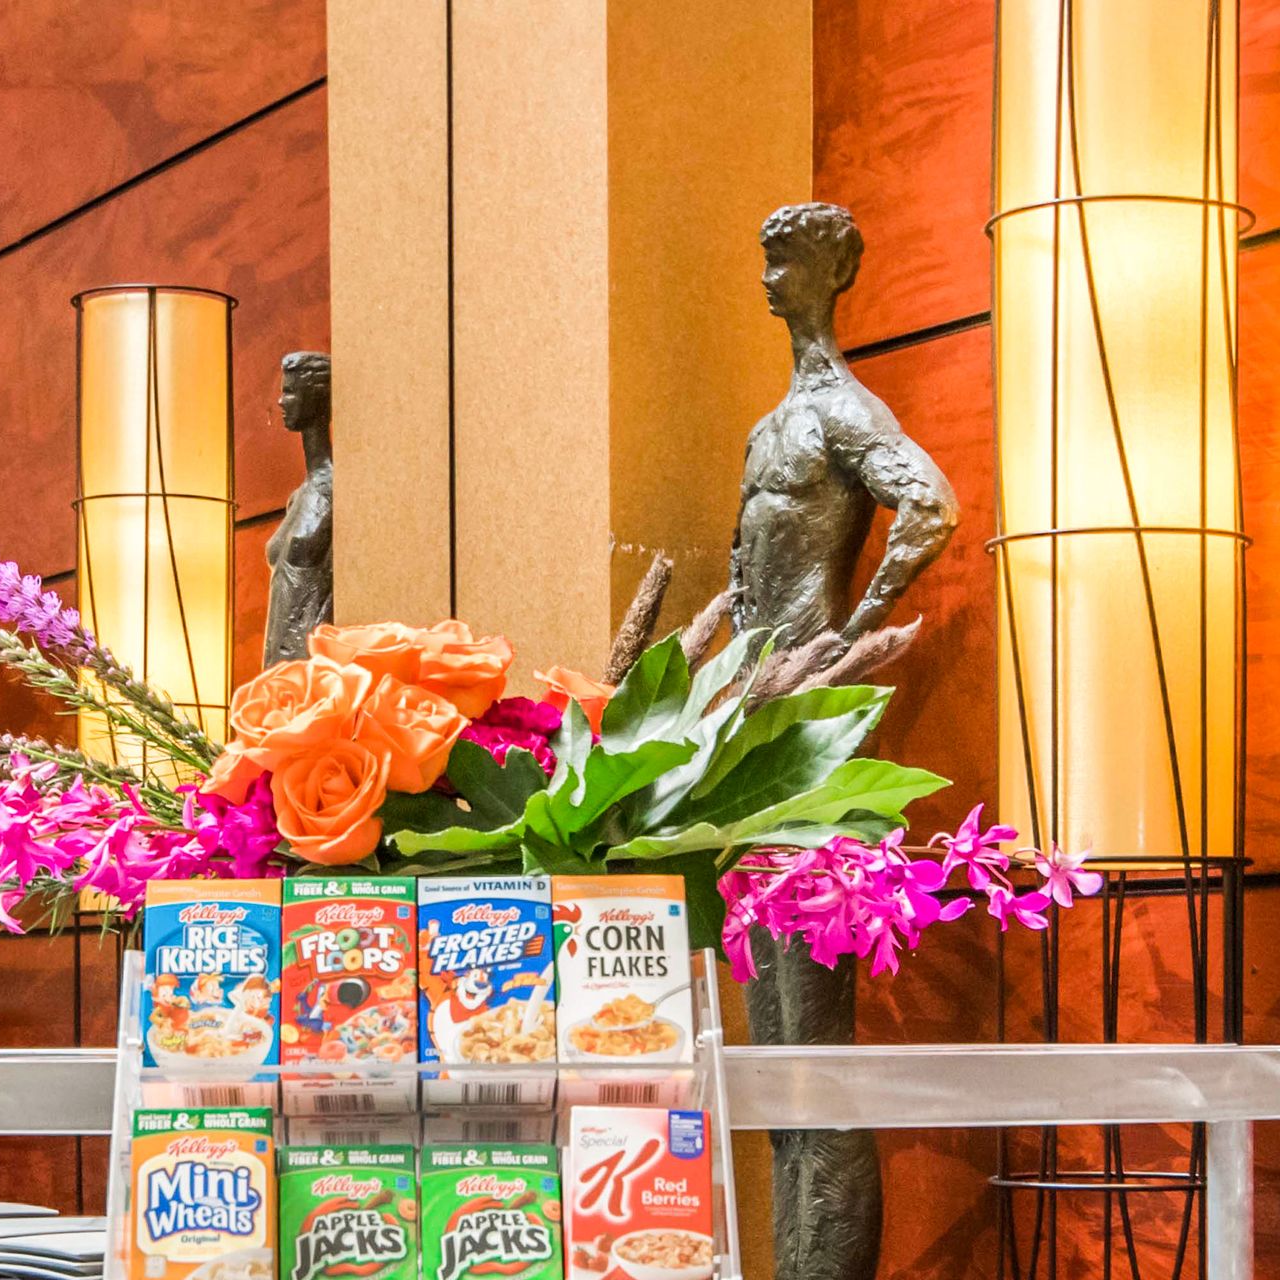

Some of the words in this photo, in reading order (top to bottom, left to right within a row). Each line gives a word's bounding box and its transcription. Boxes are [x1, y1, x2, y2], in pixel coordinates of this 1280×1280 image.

[324, 881, 345, 896] &
[381, 885, 407, 895] GRAIN
[474, 881, 533, 891] VITAMIN
[537, 881, 547, 891] D
[180, 903, 248, 926] Kellogg's
[315, 903, 384, 927] Kellogg's
[453, 903, 521, 927] Kellogg's
[599, 908, 656, 926] Kellogg's
[187, 926, 239, 949] RICE
[300, 927, 395, 960] FROOT
[430, 921, 537, 957] FROSTED
[585, 925, 665, 952] CORN
[161, 948, 266, 973] KRISPIES
[315, 948, 402, 974] LOOPS
[431, 941, 524, 976] FLAKES
[587, 956, 669, 978] FLAKES
[138, 1119, 172, 1131] FIBER
[173, 1112, 196, 1131] &
[204, 1118, 237, 1128] WHOLE
[237, 1117, 267, 1128] GRAIN
[166, 1137, 239, 1160] Kellogg's
[580, 1135, 628, 1149] Special
[320, 1149, 342, 1166] &
[463, 1149, 485, 1166] &
[149, 1161, 250, 1209] Mini
[312, 1175, 382, 1200] Kellogg's
[456, 1175, 527, 1200] Kellogg's
[579, 1138, 661, 1218] K
[654, 1177, 688, 1193] Red
[641, 1190, 700, 1207] Berries
[146, 1199, 255, 1241] Wheats
[313, 1212, 381, 1235] APPLE
[458, 1212, 525, 1233] APPLE
[180, 1234, 221, 1245] Original
